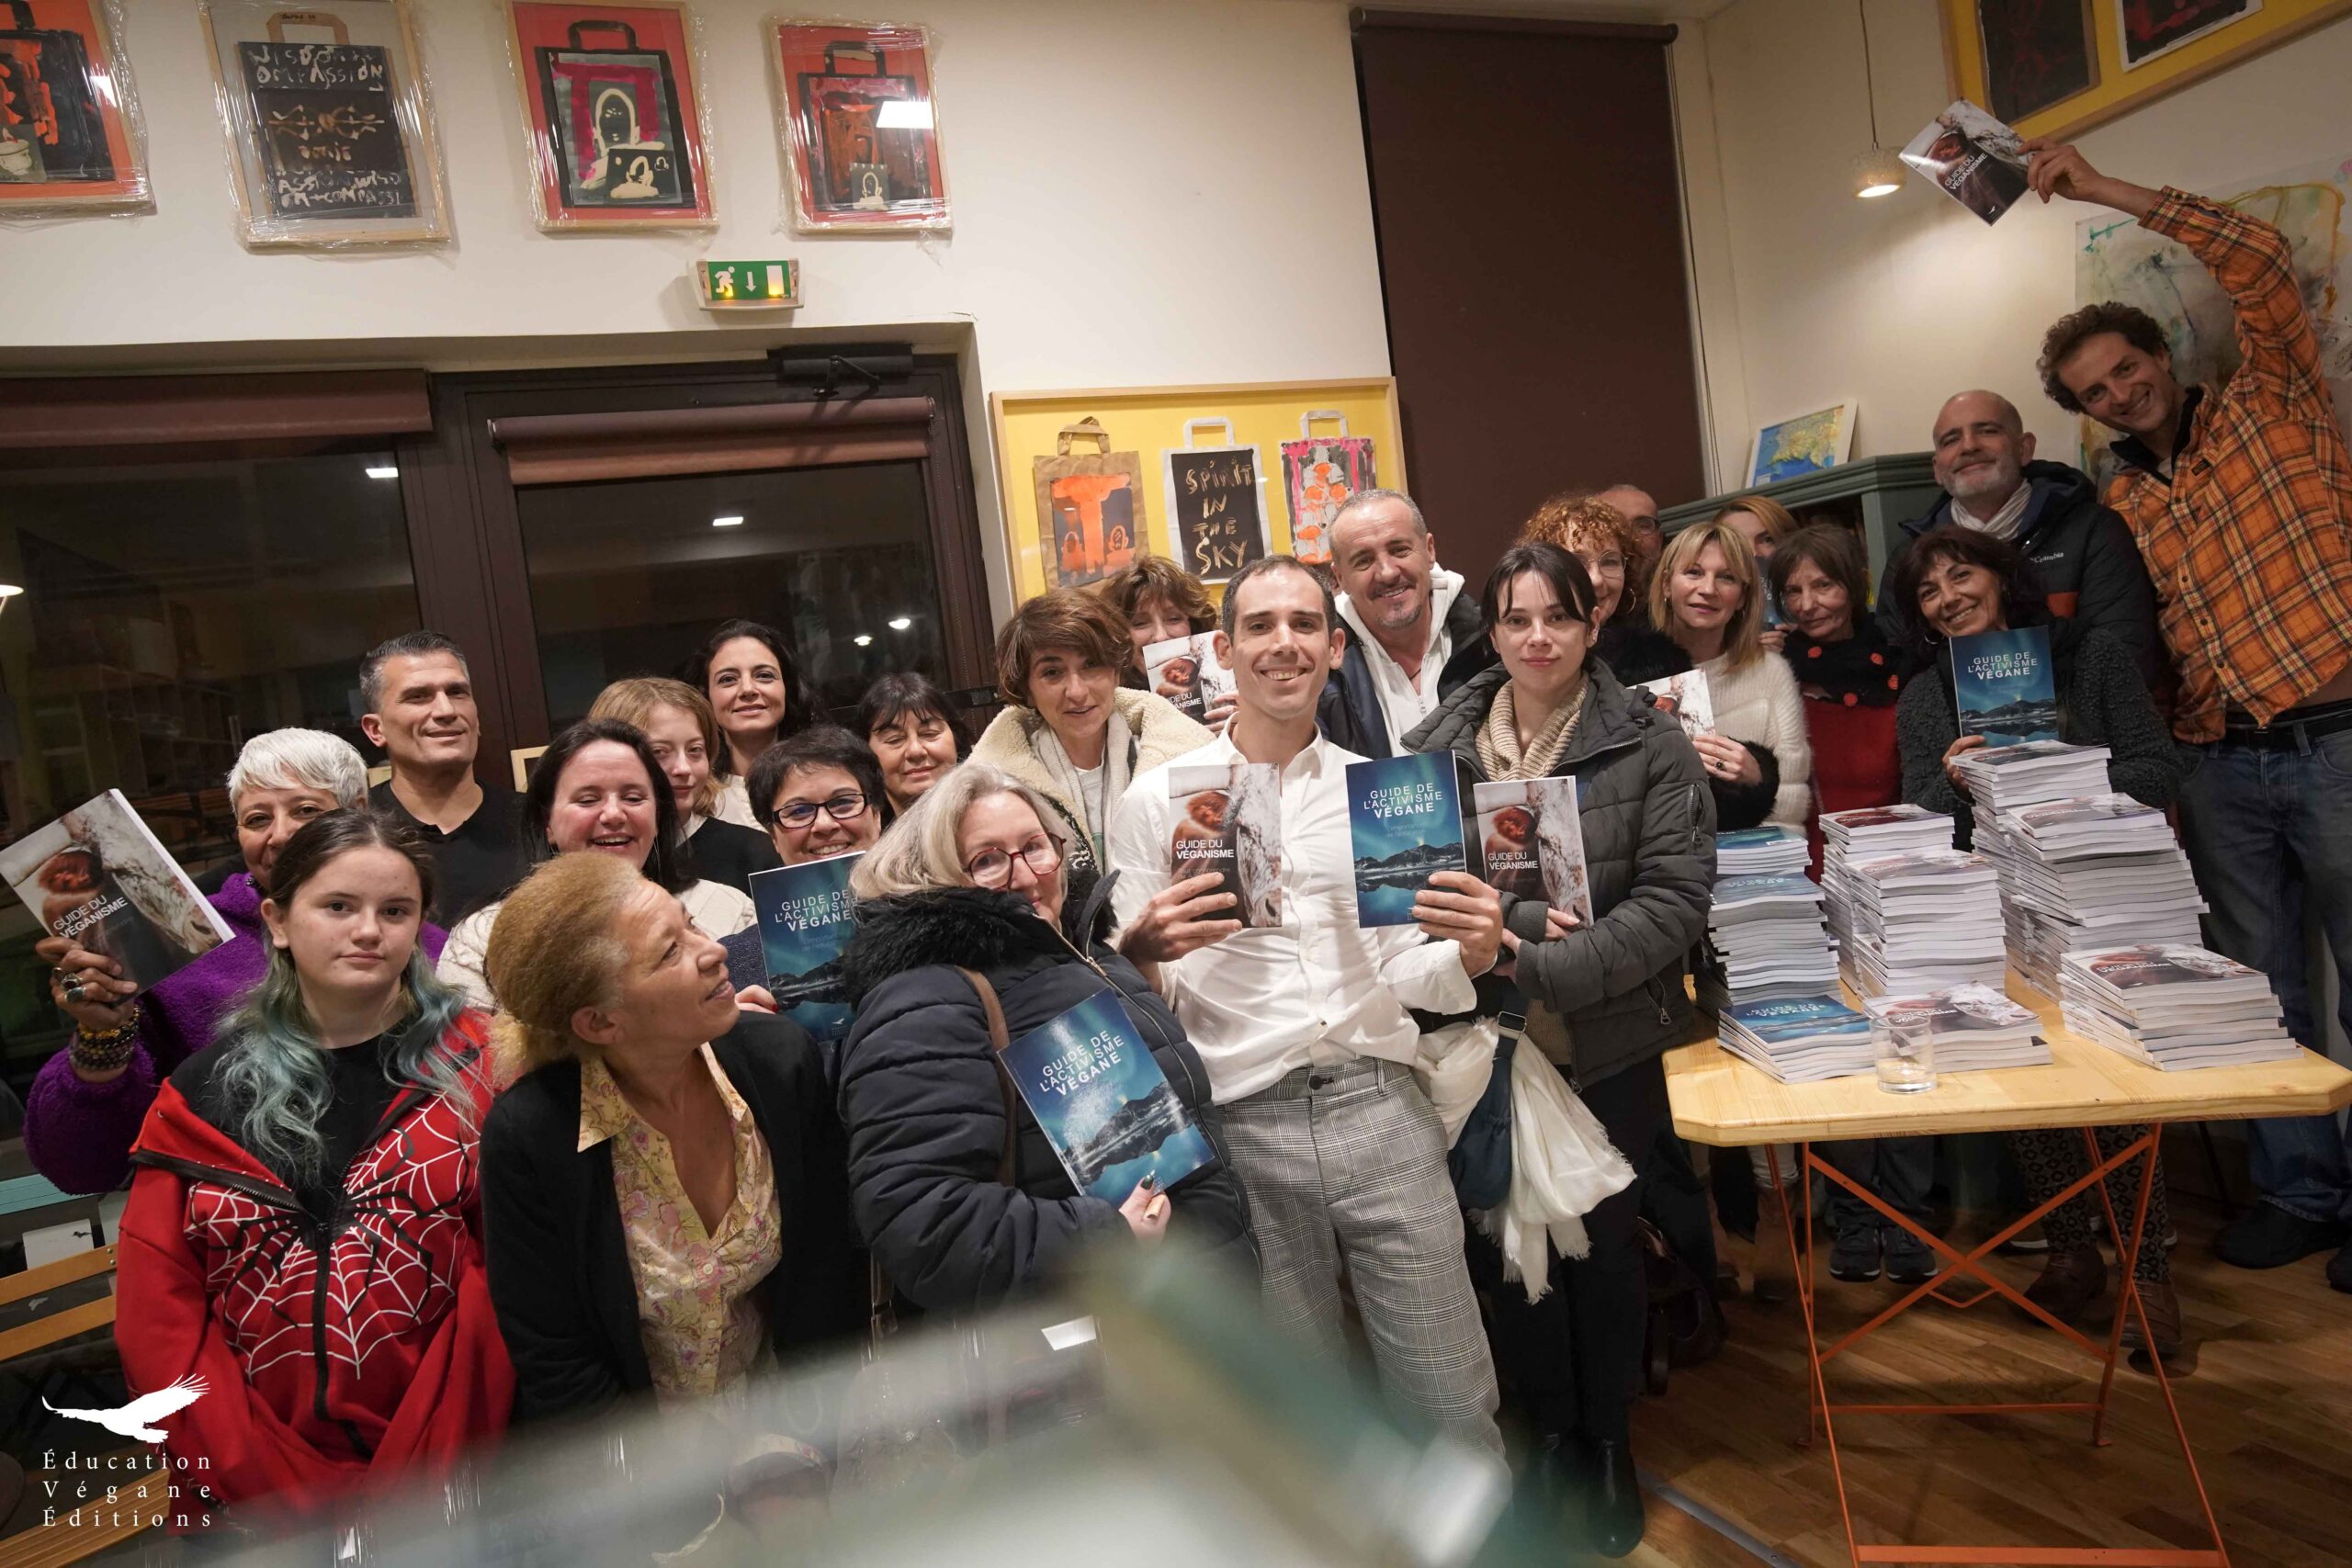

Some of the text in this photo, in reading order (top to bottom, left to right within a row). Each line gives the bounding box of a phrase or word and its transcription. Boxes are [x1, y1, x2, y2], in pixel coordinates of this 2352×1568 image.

[1945, 155, 1975, 186] GUIDE DU
[1203, 494, 1227, 519] IN
[1193, 517, 1237, 540] THE
[1196, 536, 1248, 575] SKY
[1968, 658, 2038, 673] L'ACTIVISME
[1973, 651, 2030, 665] GUIDE DE
[1977, 667, 2030, 680] VÉGANE
[1175, 697, 1203, 709] ANISME
[1182, 692, 1193, 700] DU
[1363, 791, 1443, 810] L'ACTIVISME
[1370, 783, 1434, 799] GUIDE DE
[1374, 802, 1435, 818] VÉGANE
[1176, 839, 1223, 850] GUIDE DU
[1176, 848, 1235, 859] VÉGANISME
[1488, 852, 1527, 862] GUIDE DU
[1488, 860, 1539, 870] VÉGANISME
[781, 889, 850, 911] GUIDE DE
[53, 904, 90, 931] GUIDE
[87, 895, 107, 910] DU
[60, 897, 129, 939] VÉGANISME
[787, 909, 852, 931] VÉGANE
[1043, 1030, 1111, 1077] GUIDE DE
[1039, 1035, 1125, 1093] L'ACTIVISME
[1056, 1051, 1122, 1096] VÉGANE
